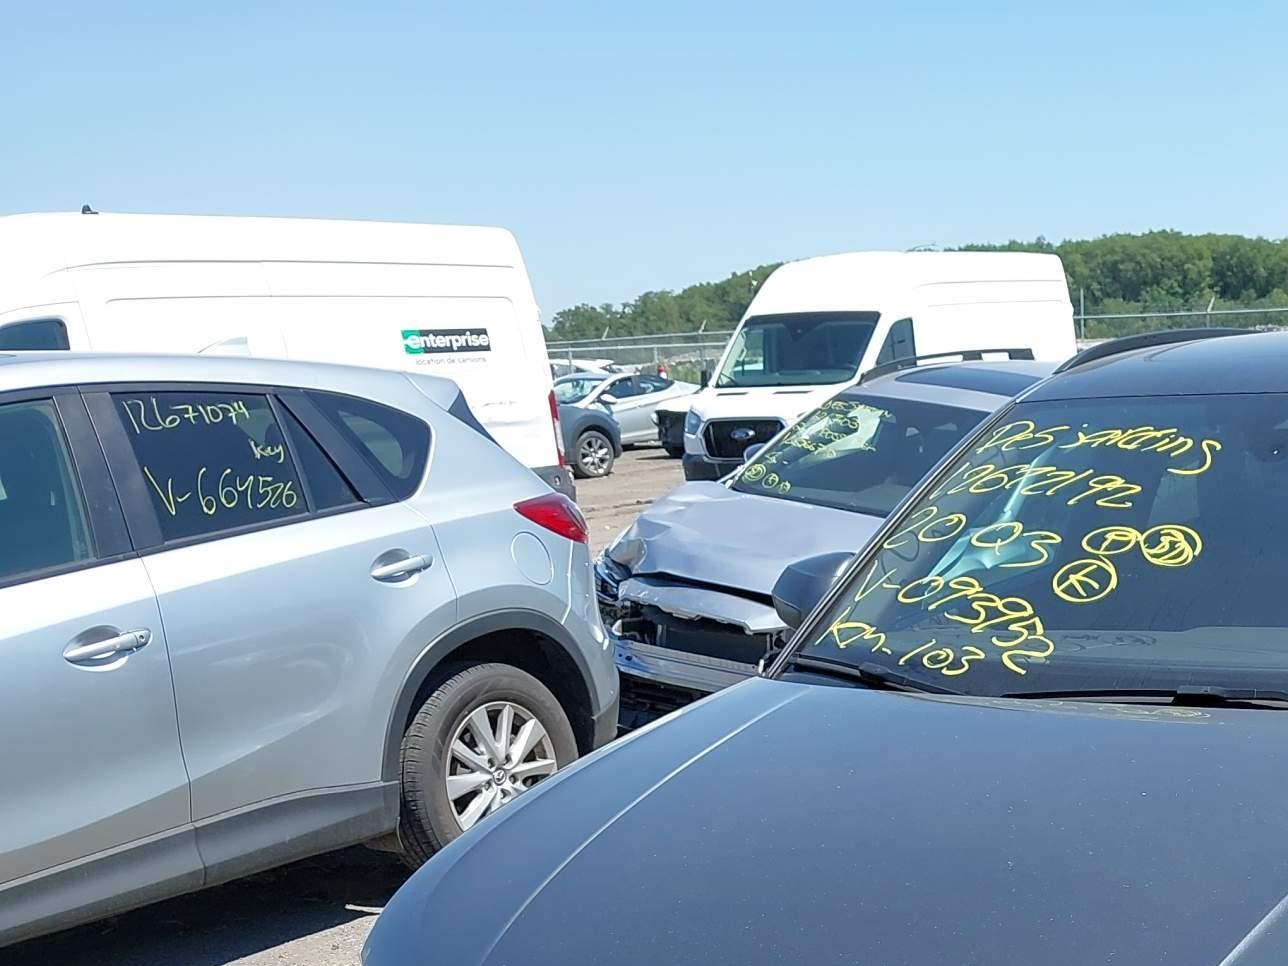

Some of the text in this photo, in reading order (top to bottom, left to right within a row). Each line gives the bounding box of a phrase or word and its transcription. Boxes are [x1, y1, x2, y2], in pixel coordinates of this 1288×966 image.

[404, 330, 490, 351] enterprise
[122, 396, 250, 435] 12671074
[928, 461, 1143, 509] 12672192
